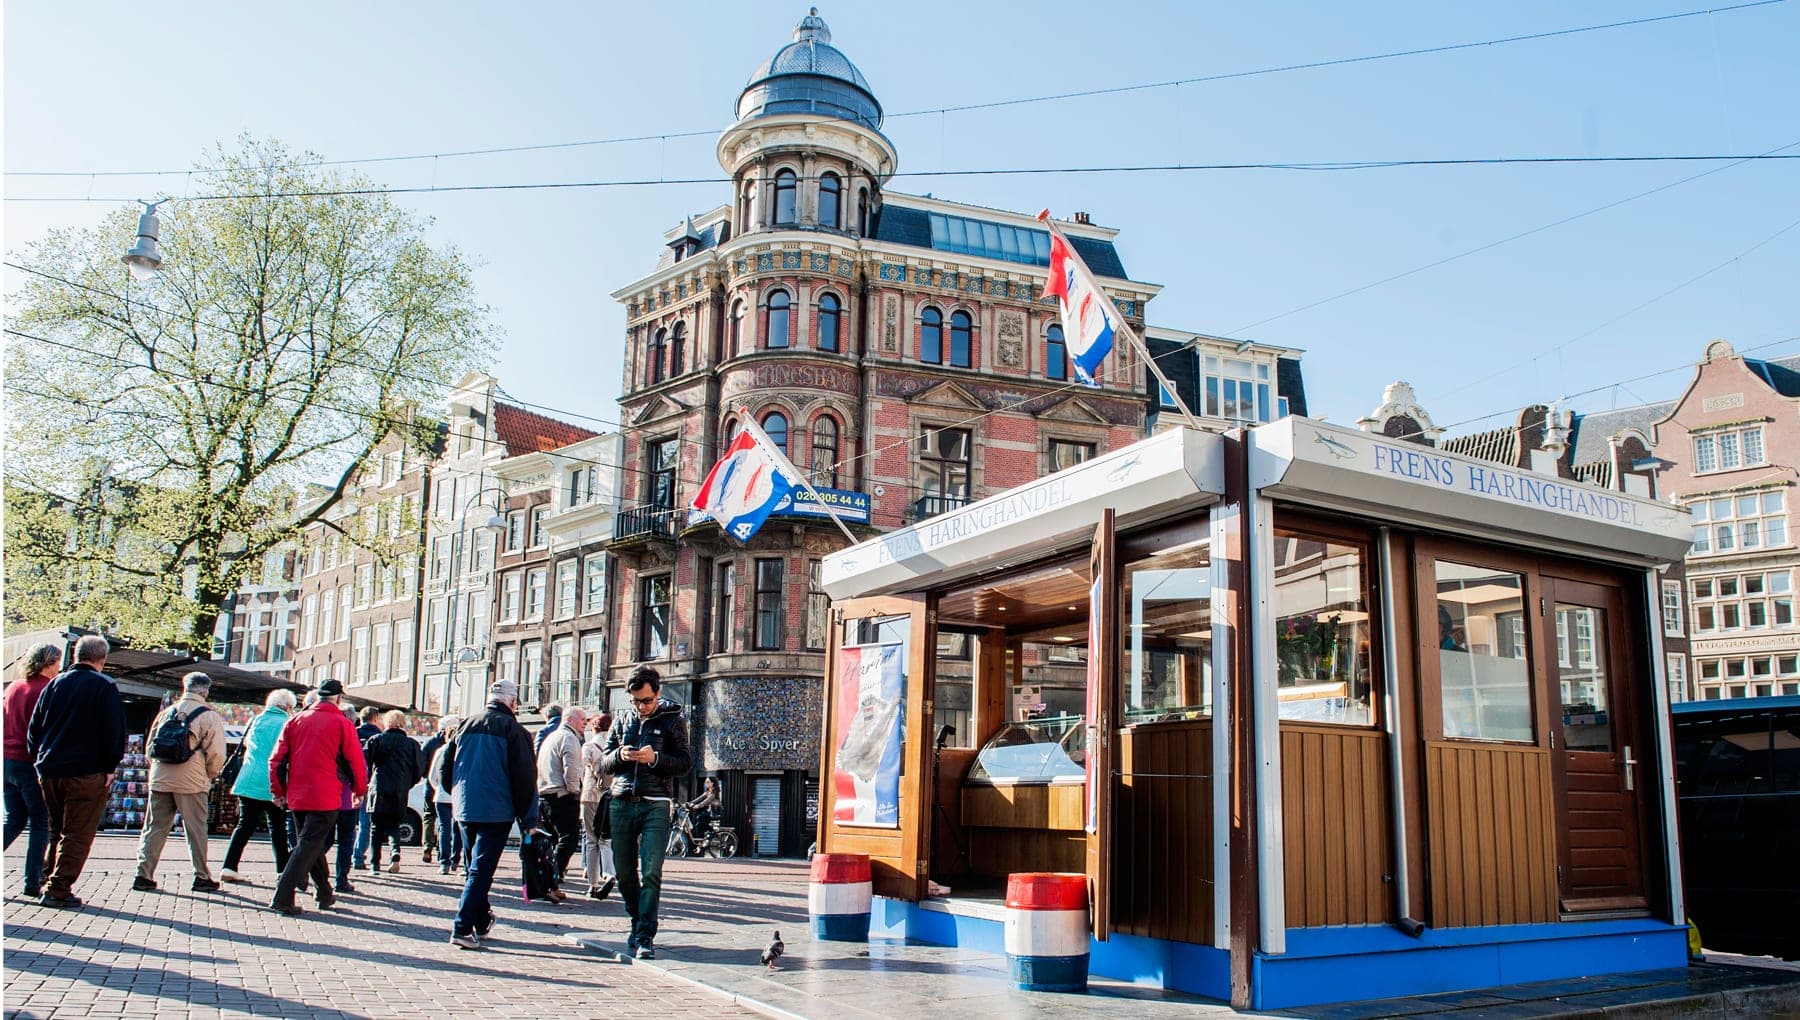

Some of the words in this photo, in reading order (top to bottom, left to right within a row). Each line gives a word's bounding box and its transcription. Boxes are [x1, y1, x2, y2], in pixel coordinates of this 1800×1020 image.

[819, 492, 838, 503] 305
[840, 495, 852, 505] 44
[855, 497, 865, 507] 44
[1373, 444, 1454, 486] FRENS
[1468, 466, 1644, 527] HARINGHANDEL
[879, 531, 921, 563] FRENS
[929, 480, 1072, 547] HARINGHANDEL
[725, 735, 746, 750] Ace
[759, 735, 800, 753] Spyer
